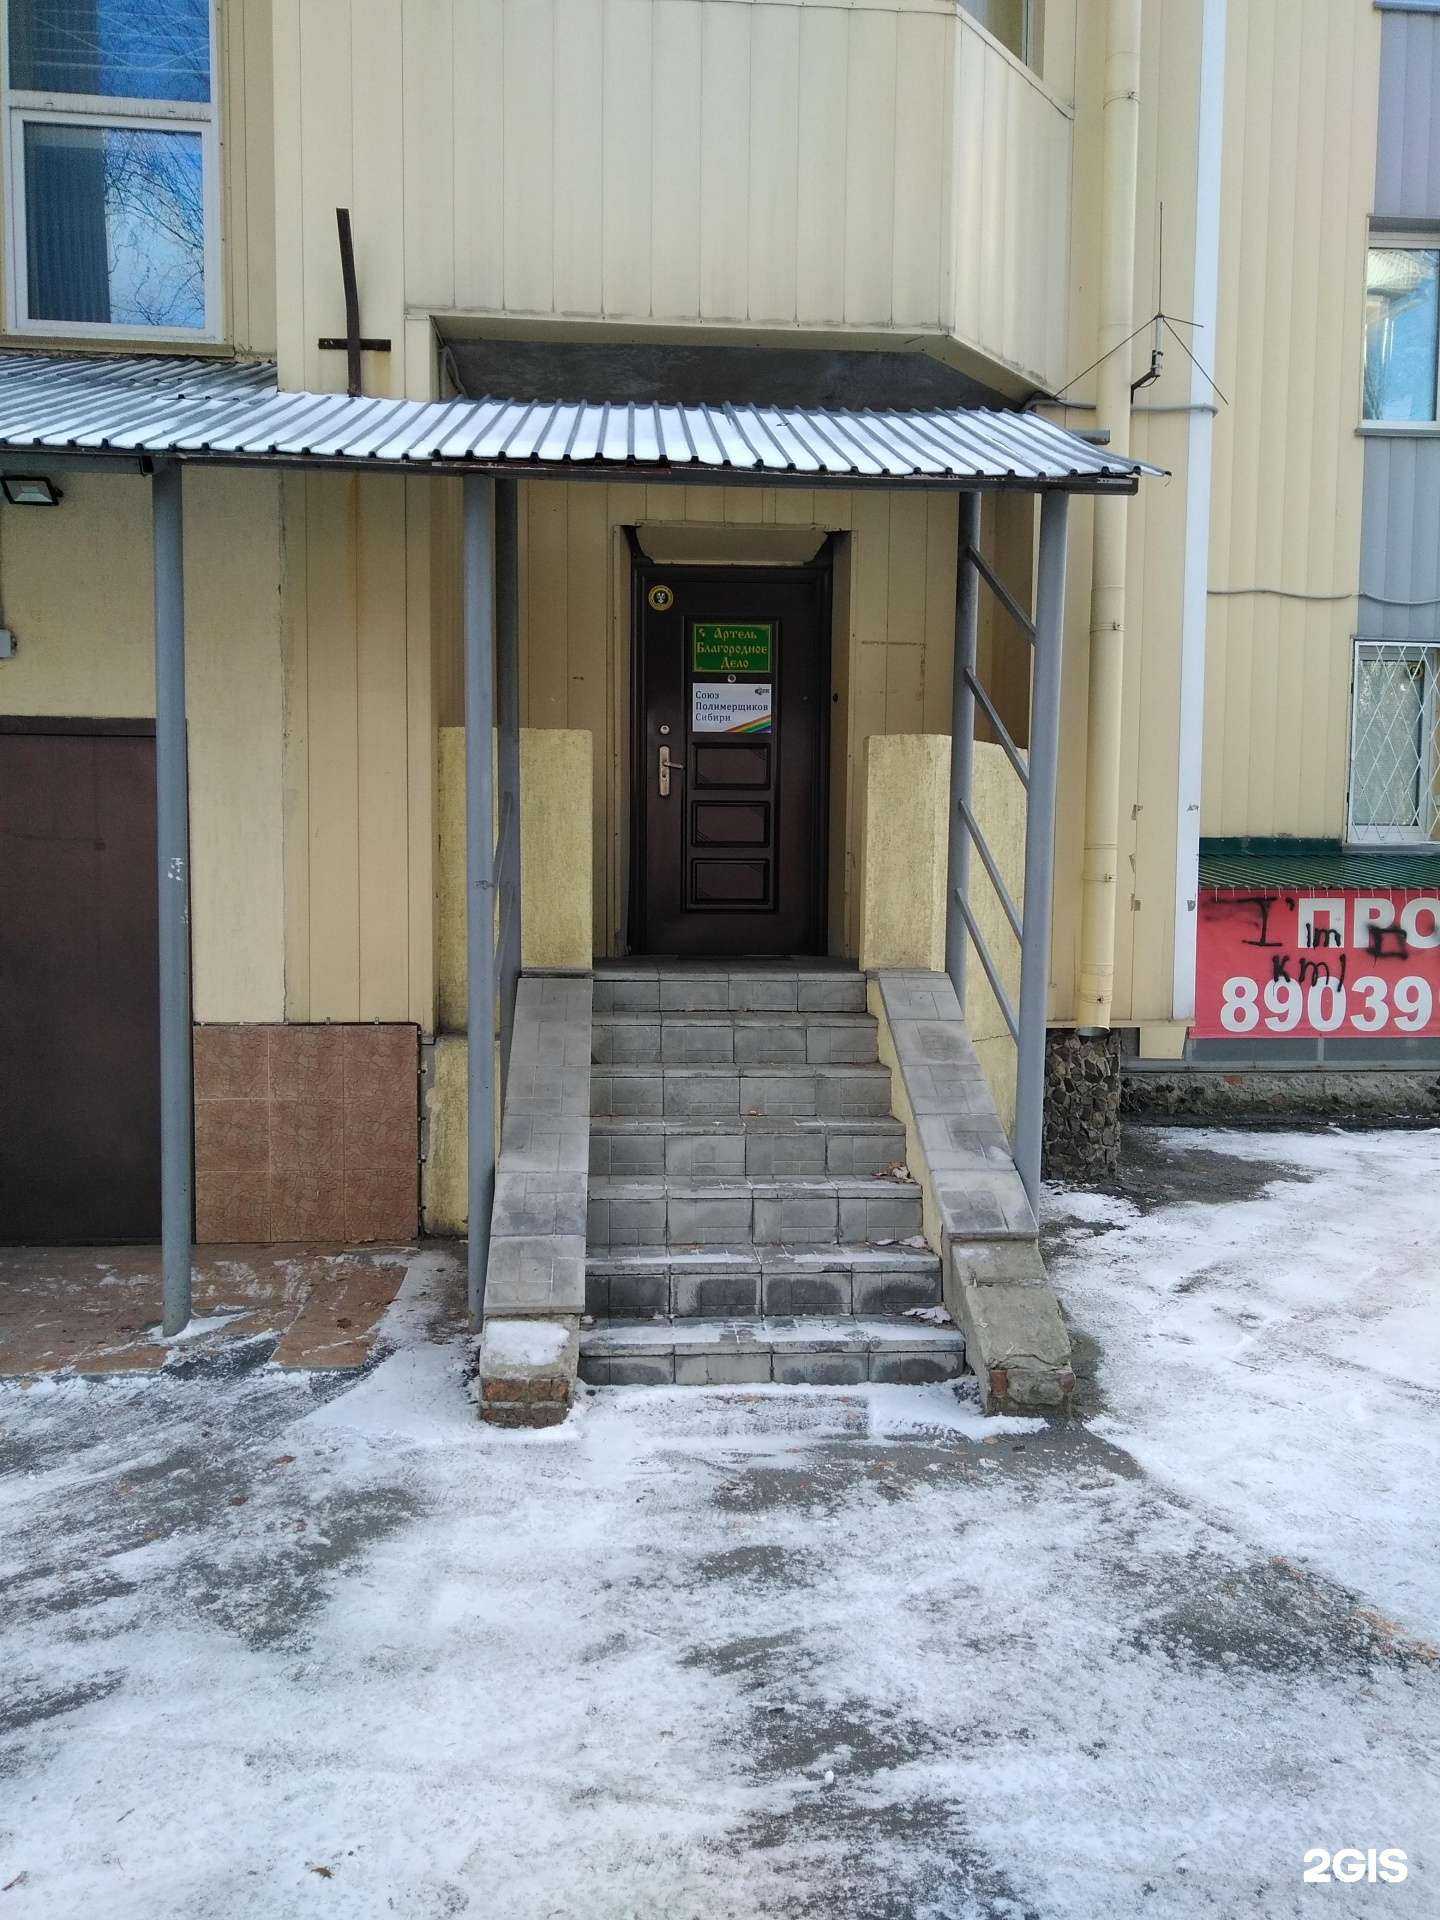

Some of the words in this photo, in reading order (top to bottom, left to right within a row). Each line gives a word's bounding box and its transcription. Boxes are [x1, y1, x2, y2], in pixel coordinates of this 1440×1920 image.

[714, 627, 757, 641] Артель
[697, 643, 767, 656] Благородное
[721, 658, 749, 669] Дело
[695, 691, 719, 699] Союз
[695, 702, 768, 712] Полимерщиков
[695, 713, 731, 723] Сибири
